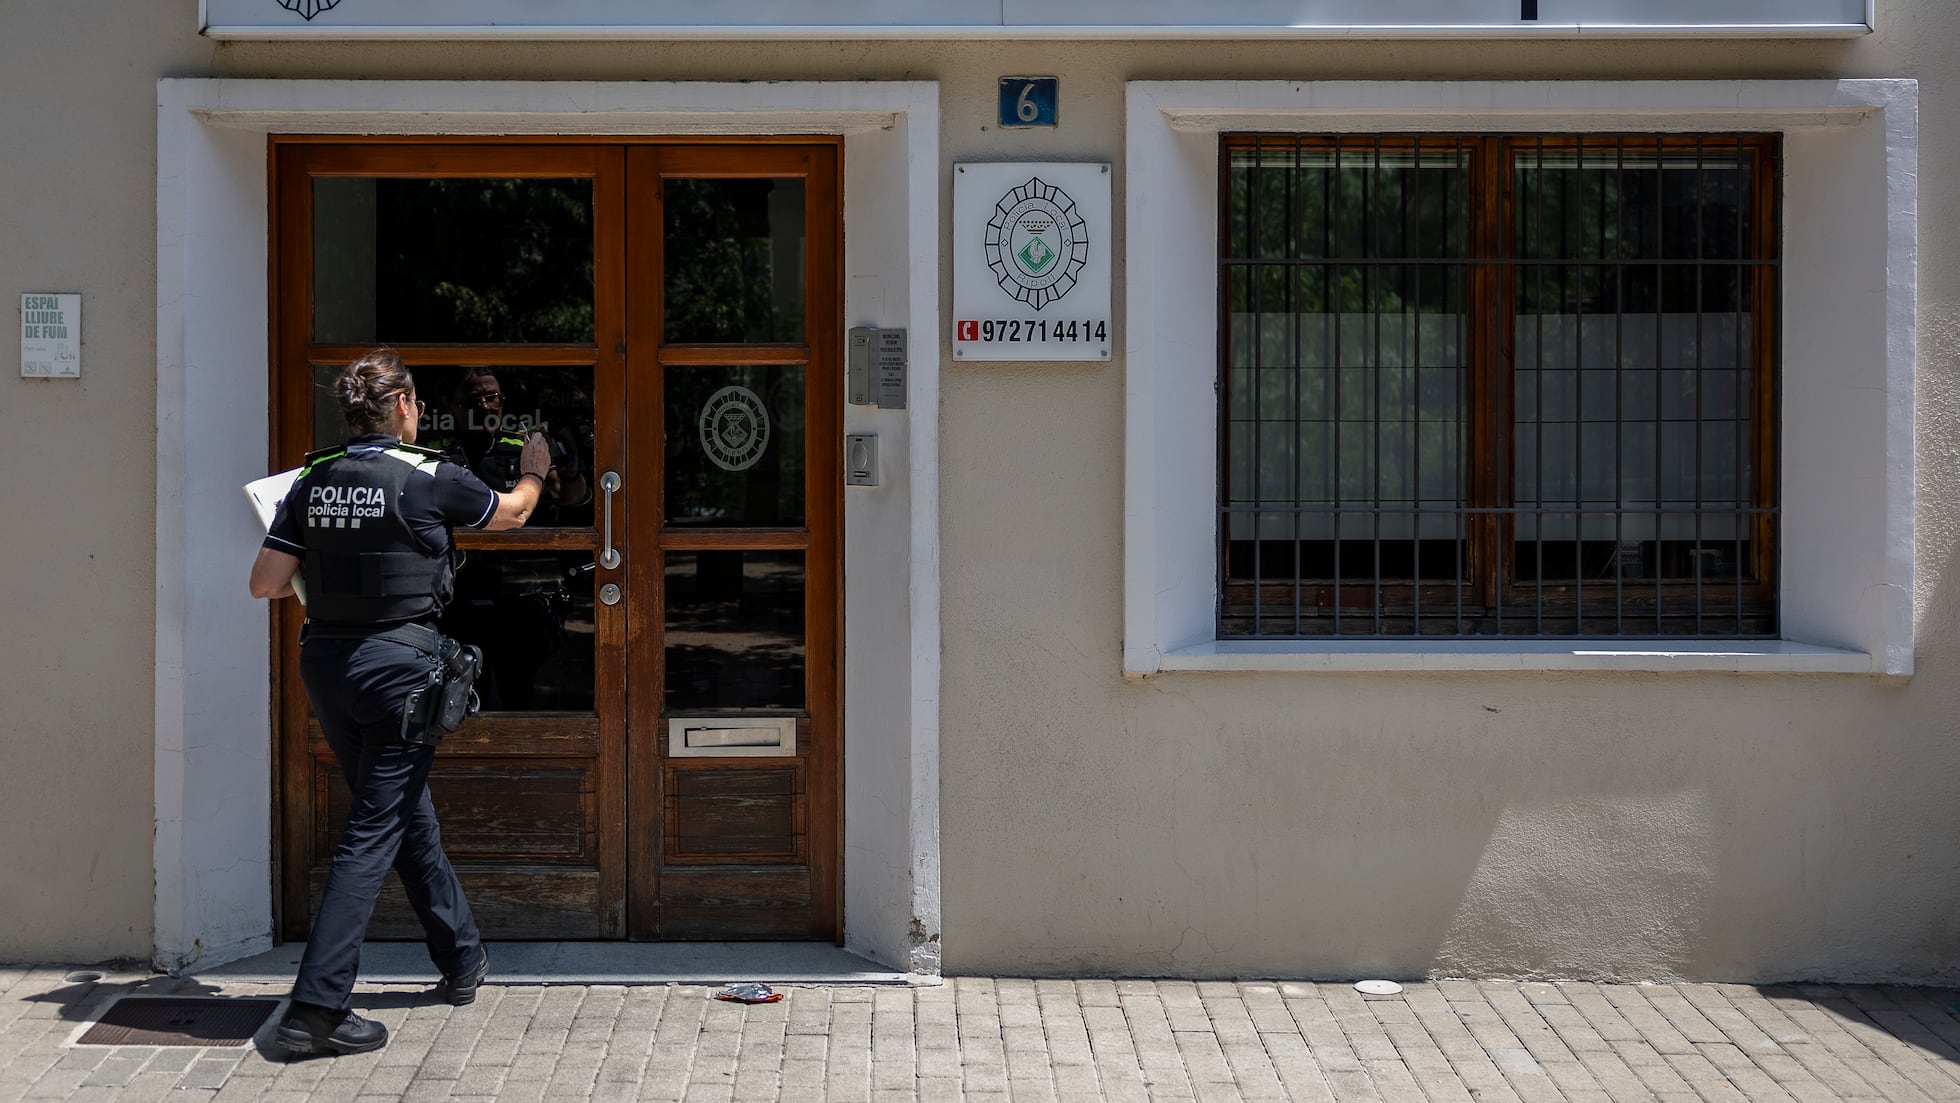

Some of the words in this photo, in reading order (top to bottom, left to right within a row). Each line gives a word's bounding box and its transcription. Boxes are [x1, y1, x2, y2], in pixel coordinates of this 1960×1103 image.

[1017, 83, 1038, 122] 6
[1043, 202, 1069, 231] Local
[24, 296, 59, 310] ESPAI
[24, 311, 65, 325] LLIURE
[24, 325, 40, 339] DE
[42, 325, 68, 339] FUM
[468, 408, 541, 431] Local
[309, 485, 386, 505] POLICIA
[307, 503, 349, 518] policia
[352, 504, 385, 518] local
